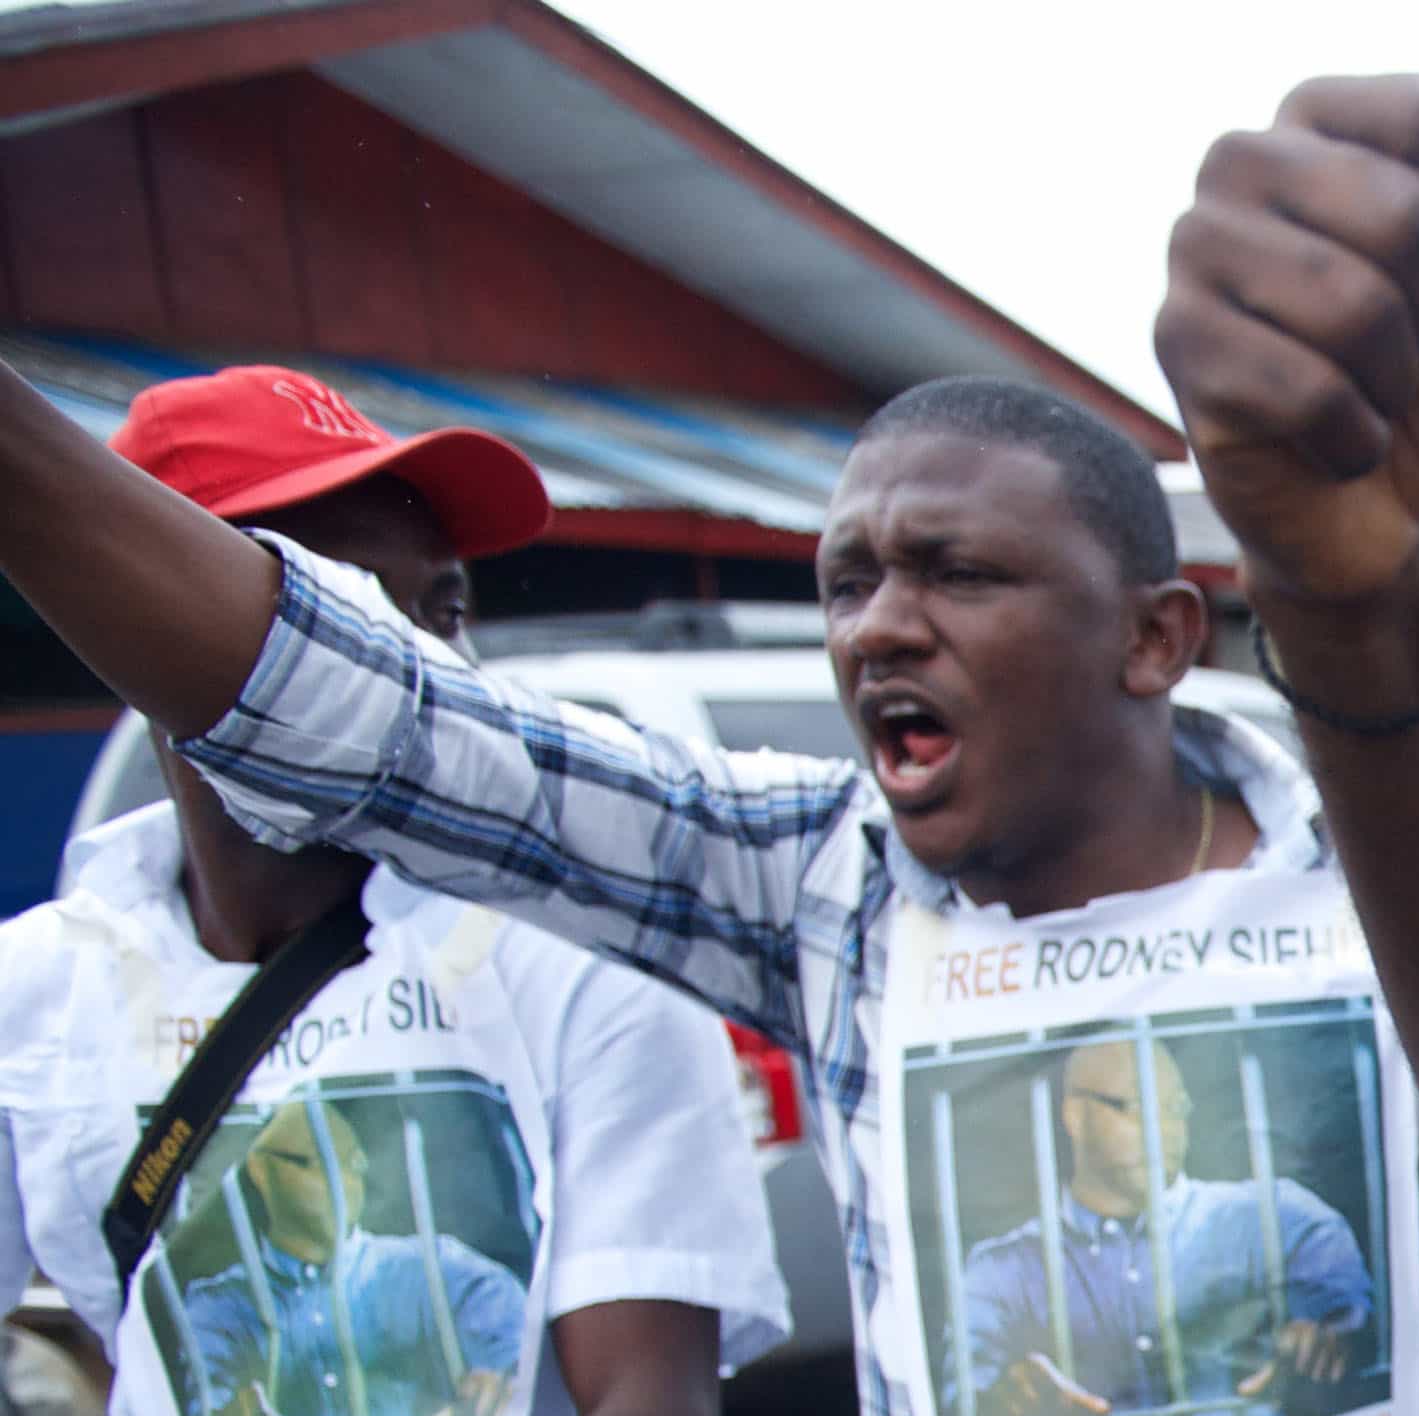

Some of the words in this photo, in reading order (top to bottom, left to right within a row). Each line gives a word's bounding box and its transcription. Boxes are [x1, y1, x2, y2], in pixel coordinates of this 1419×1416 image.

[921, 943, 1024, 1005] FREE
[1033, 929, 1212, 990] RODNEY
[132, 1118, 194, 1206] Nikon
